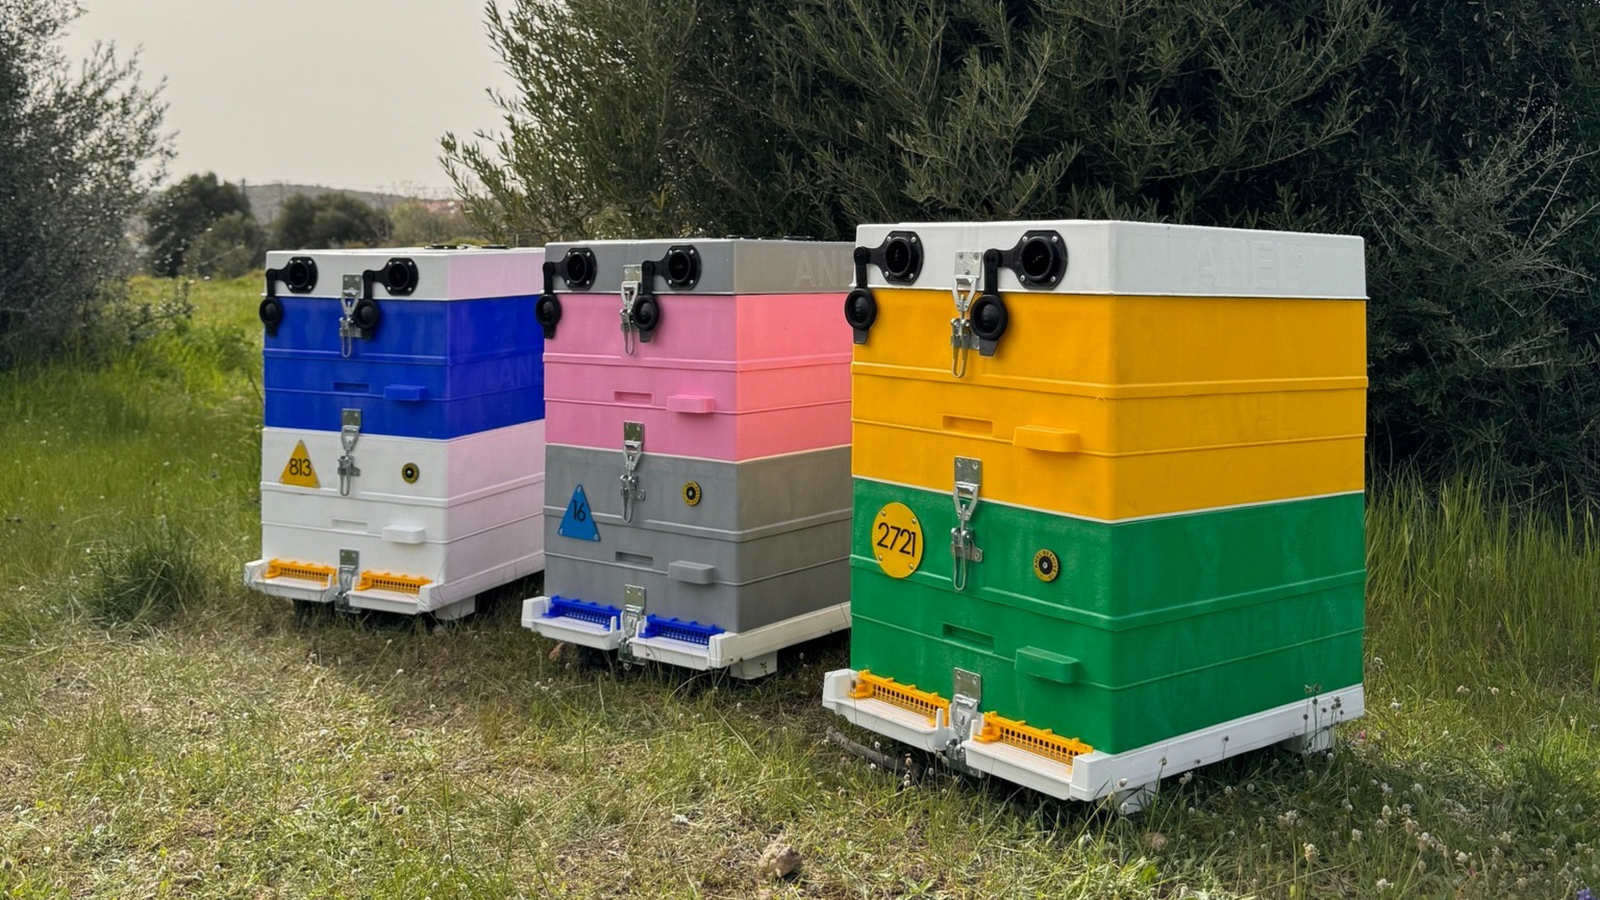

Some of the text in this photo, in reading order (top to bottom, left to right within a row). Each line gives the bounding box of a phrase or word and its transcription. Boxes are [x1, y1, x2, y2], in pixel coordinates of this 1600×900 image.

[289, 458, 312, 477] 813
[572, 499, 586, 522] 16
[876, 522, 916, 558] 2721
